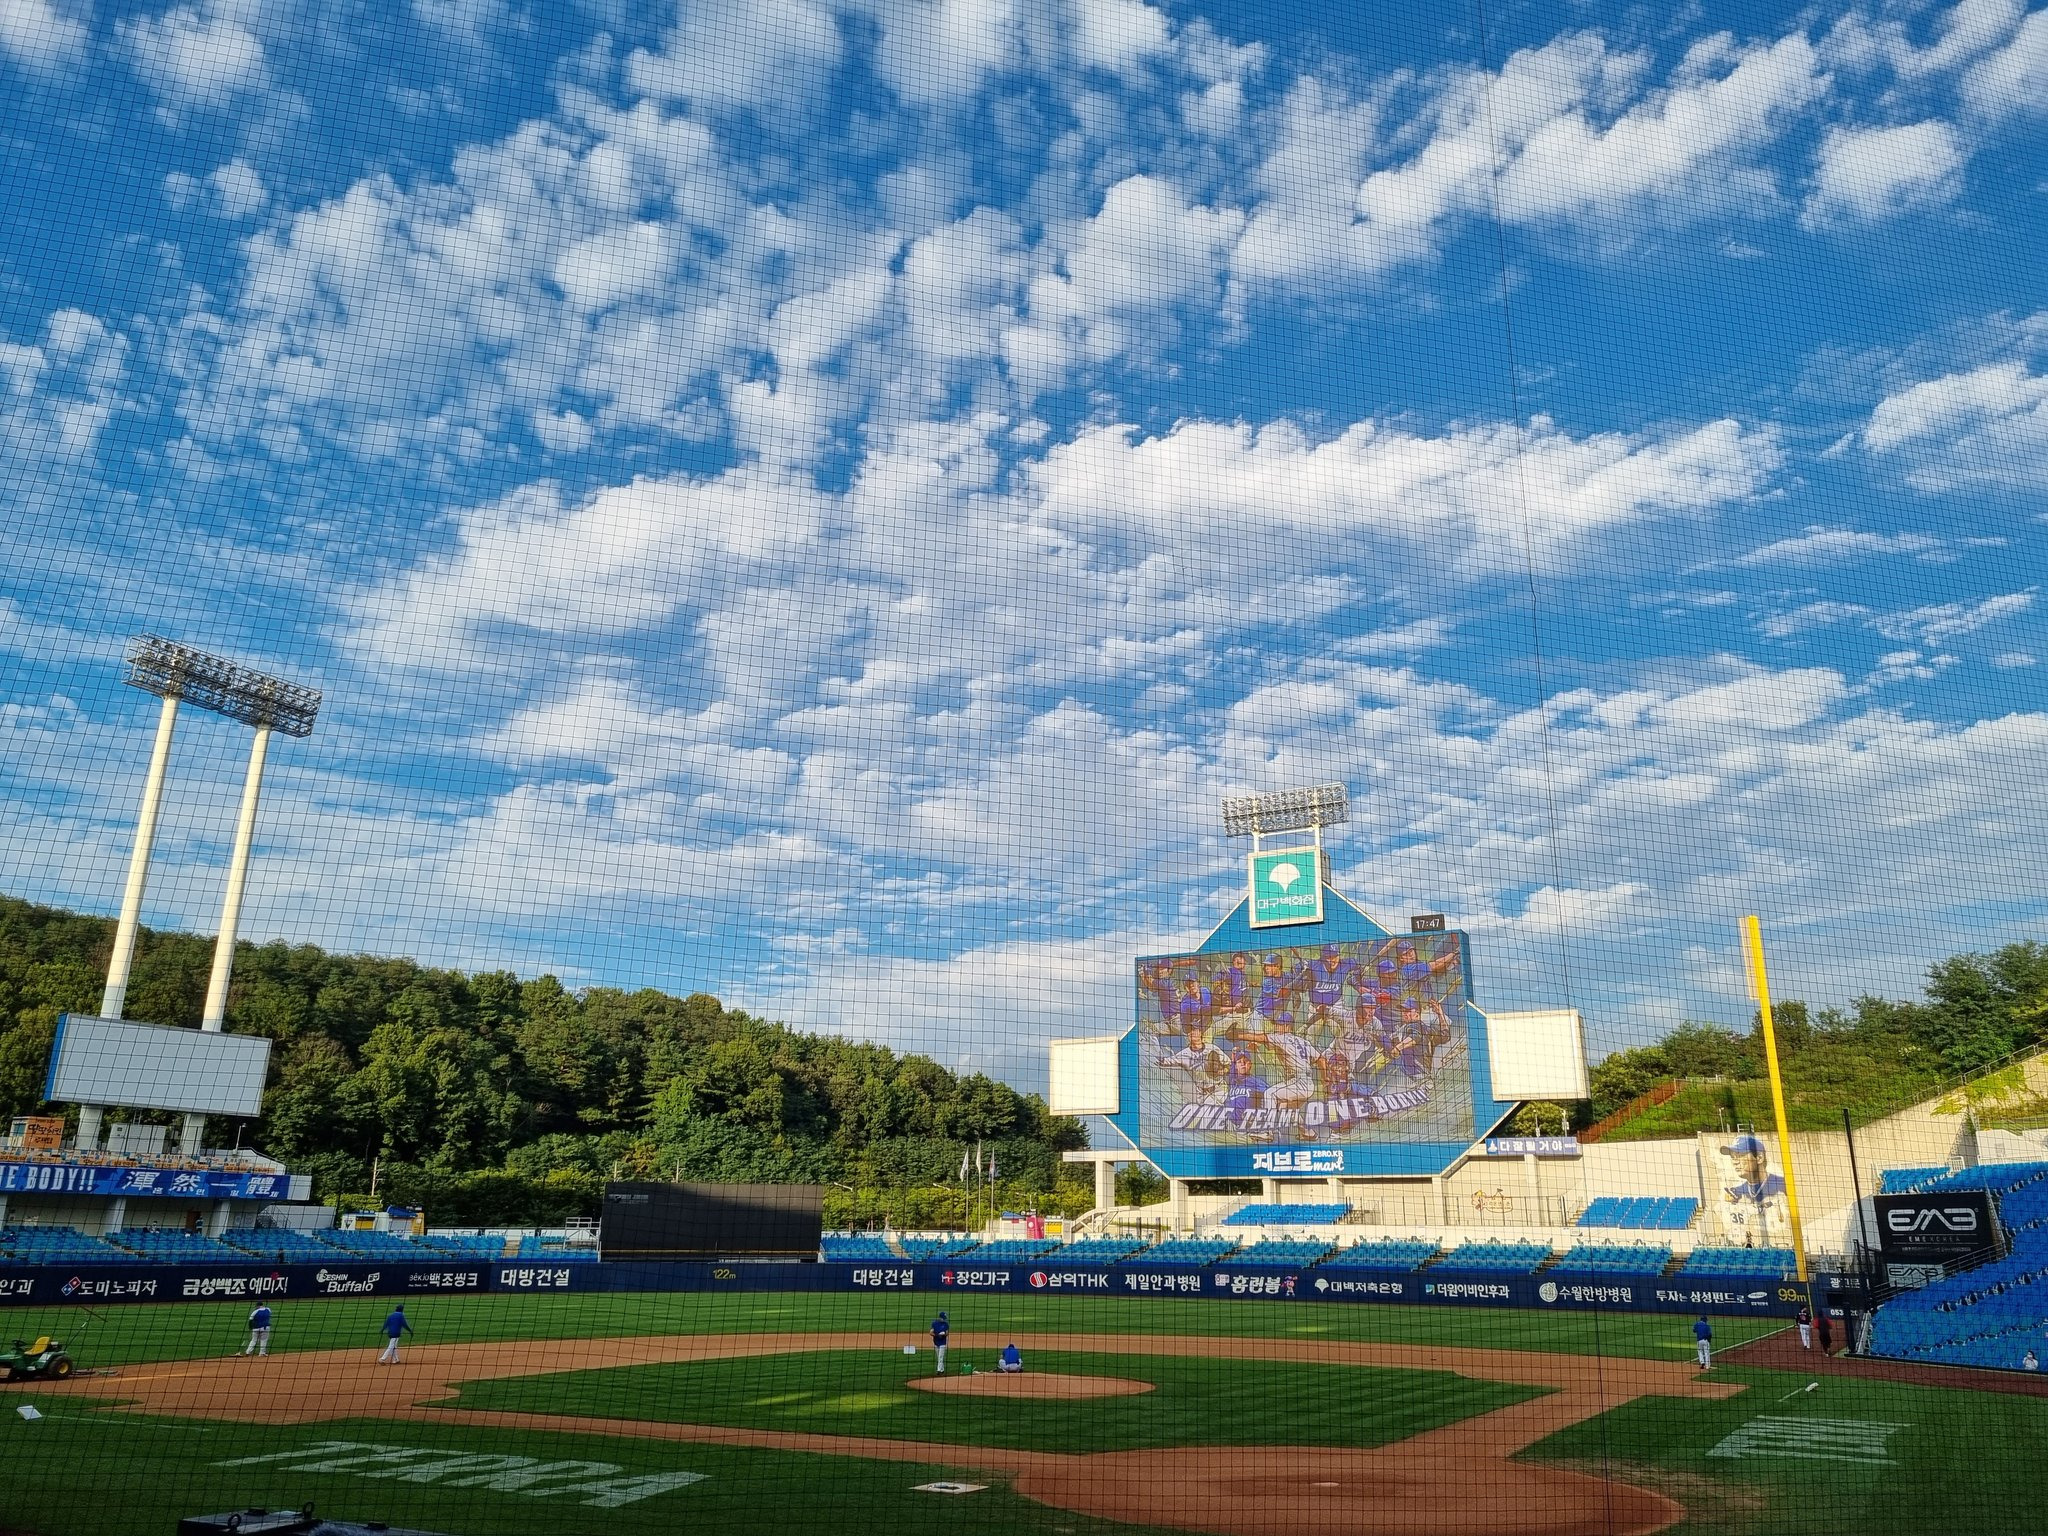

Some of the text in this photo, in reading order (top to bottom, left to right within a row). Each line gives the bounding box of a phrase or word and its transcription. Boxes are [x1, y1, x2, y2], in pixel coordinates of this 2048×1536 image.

[1257, 894, 1314, 909] 대구백화점
[1416, 918, 1440, 929] 17:47
[1169, 1103, 1235, 1129] ONE
[1239, 1108, 1301, 1130] TEAM!
[1305, 1097, 1369, 1125] ONE
[1253, 1151, 1313, 1171] 지브로
[1313, 1157, 1344, 1171] mart
[0, 1163, 20, 1189] E
[25, 1166, 96, 1191] BODY!!
[1730, 1212, 1744, 1224] 36
[429, 1272, 479, 1287] 백조씽크
[501, 1268, 570, 1286] 대방건설
[853, 1269, 914, 1286] 대방건설
[956, 1271, 1010, 1286] 장인가구
[1048, 1272, 1109, 1288] 삼익THK
[1231, 1275, 1281, 1294] 홈런볼
[78, 1280, 158, 1297] 도미노피자
[182, 1277, 248, 1296] 금성백조
[327, 1280, 374, 1293] Buffalo
[1330, 1281, 1403, 1294] 대백저축은행
[1437, 1283, 1510, 1298] 더원이비인후과
[1559, 1286, 1633, 1303] 수월한방병원
[1777, 1288, 1807, 1302] 99m
